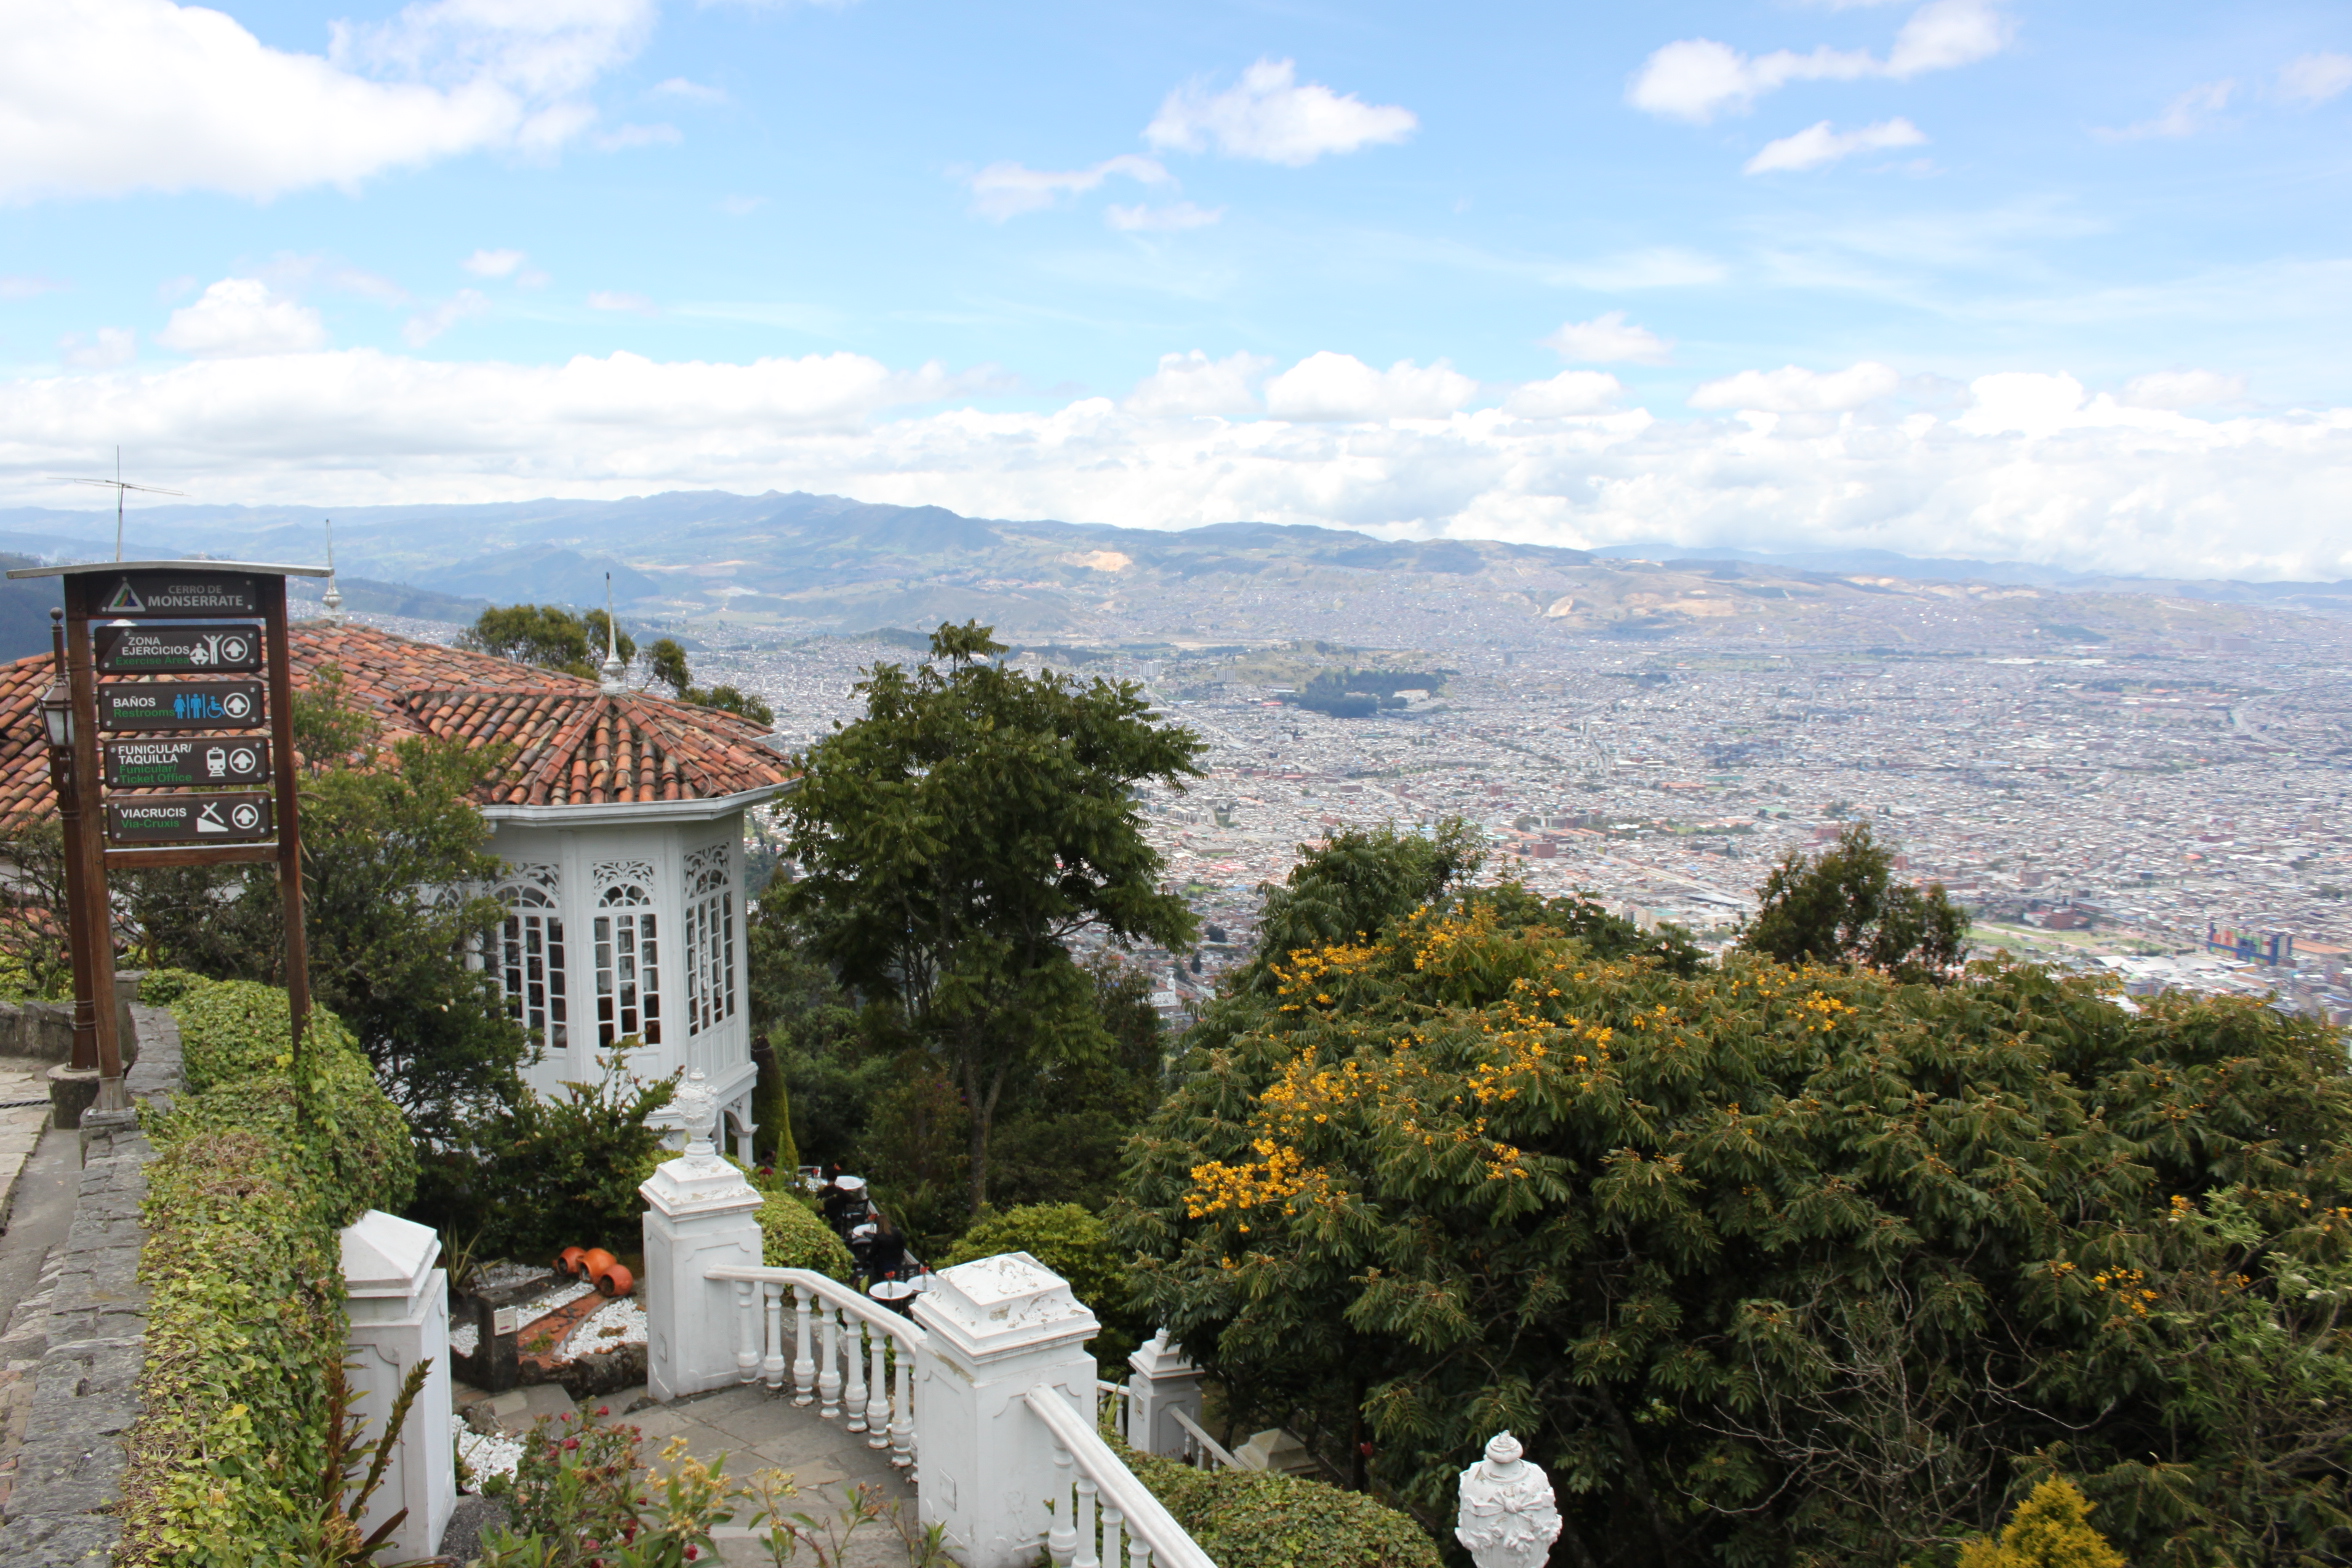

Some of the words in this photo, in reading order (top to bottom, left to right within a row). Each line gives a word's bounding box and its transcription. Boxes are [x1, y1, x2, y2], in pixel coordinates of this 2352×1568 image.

[168, 585, 205, 594] CERRO
[208, 585, 222, 594] DE
[148, 595, 243, 607] MONSERRATE
[128, 636, 161, 646] ZONA
[122, 645, 190, 656] EJERCICIOS
[115, 656, 161, 666] Exercise
[164, 656, 190, 665] Area
[113, 696, 156, 708] BAÑOS
[113, 708, 175, 718] Restrooms
[118, 743, 192, 755] FUNICULAR/
[118, 753, 179, 765] TAQUILLA
[119, 764, 177, 774] Funicular/
[120, 774, 154, 784] Ticket
[157, 773, 192, 783] Office
[120, 807, 187, 818] VIACRUCIS
[121, 818, 180, 828] Via-Cruxis
